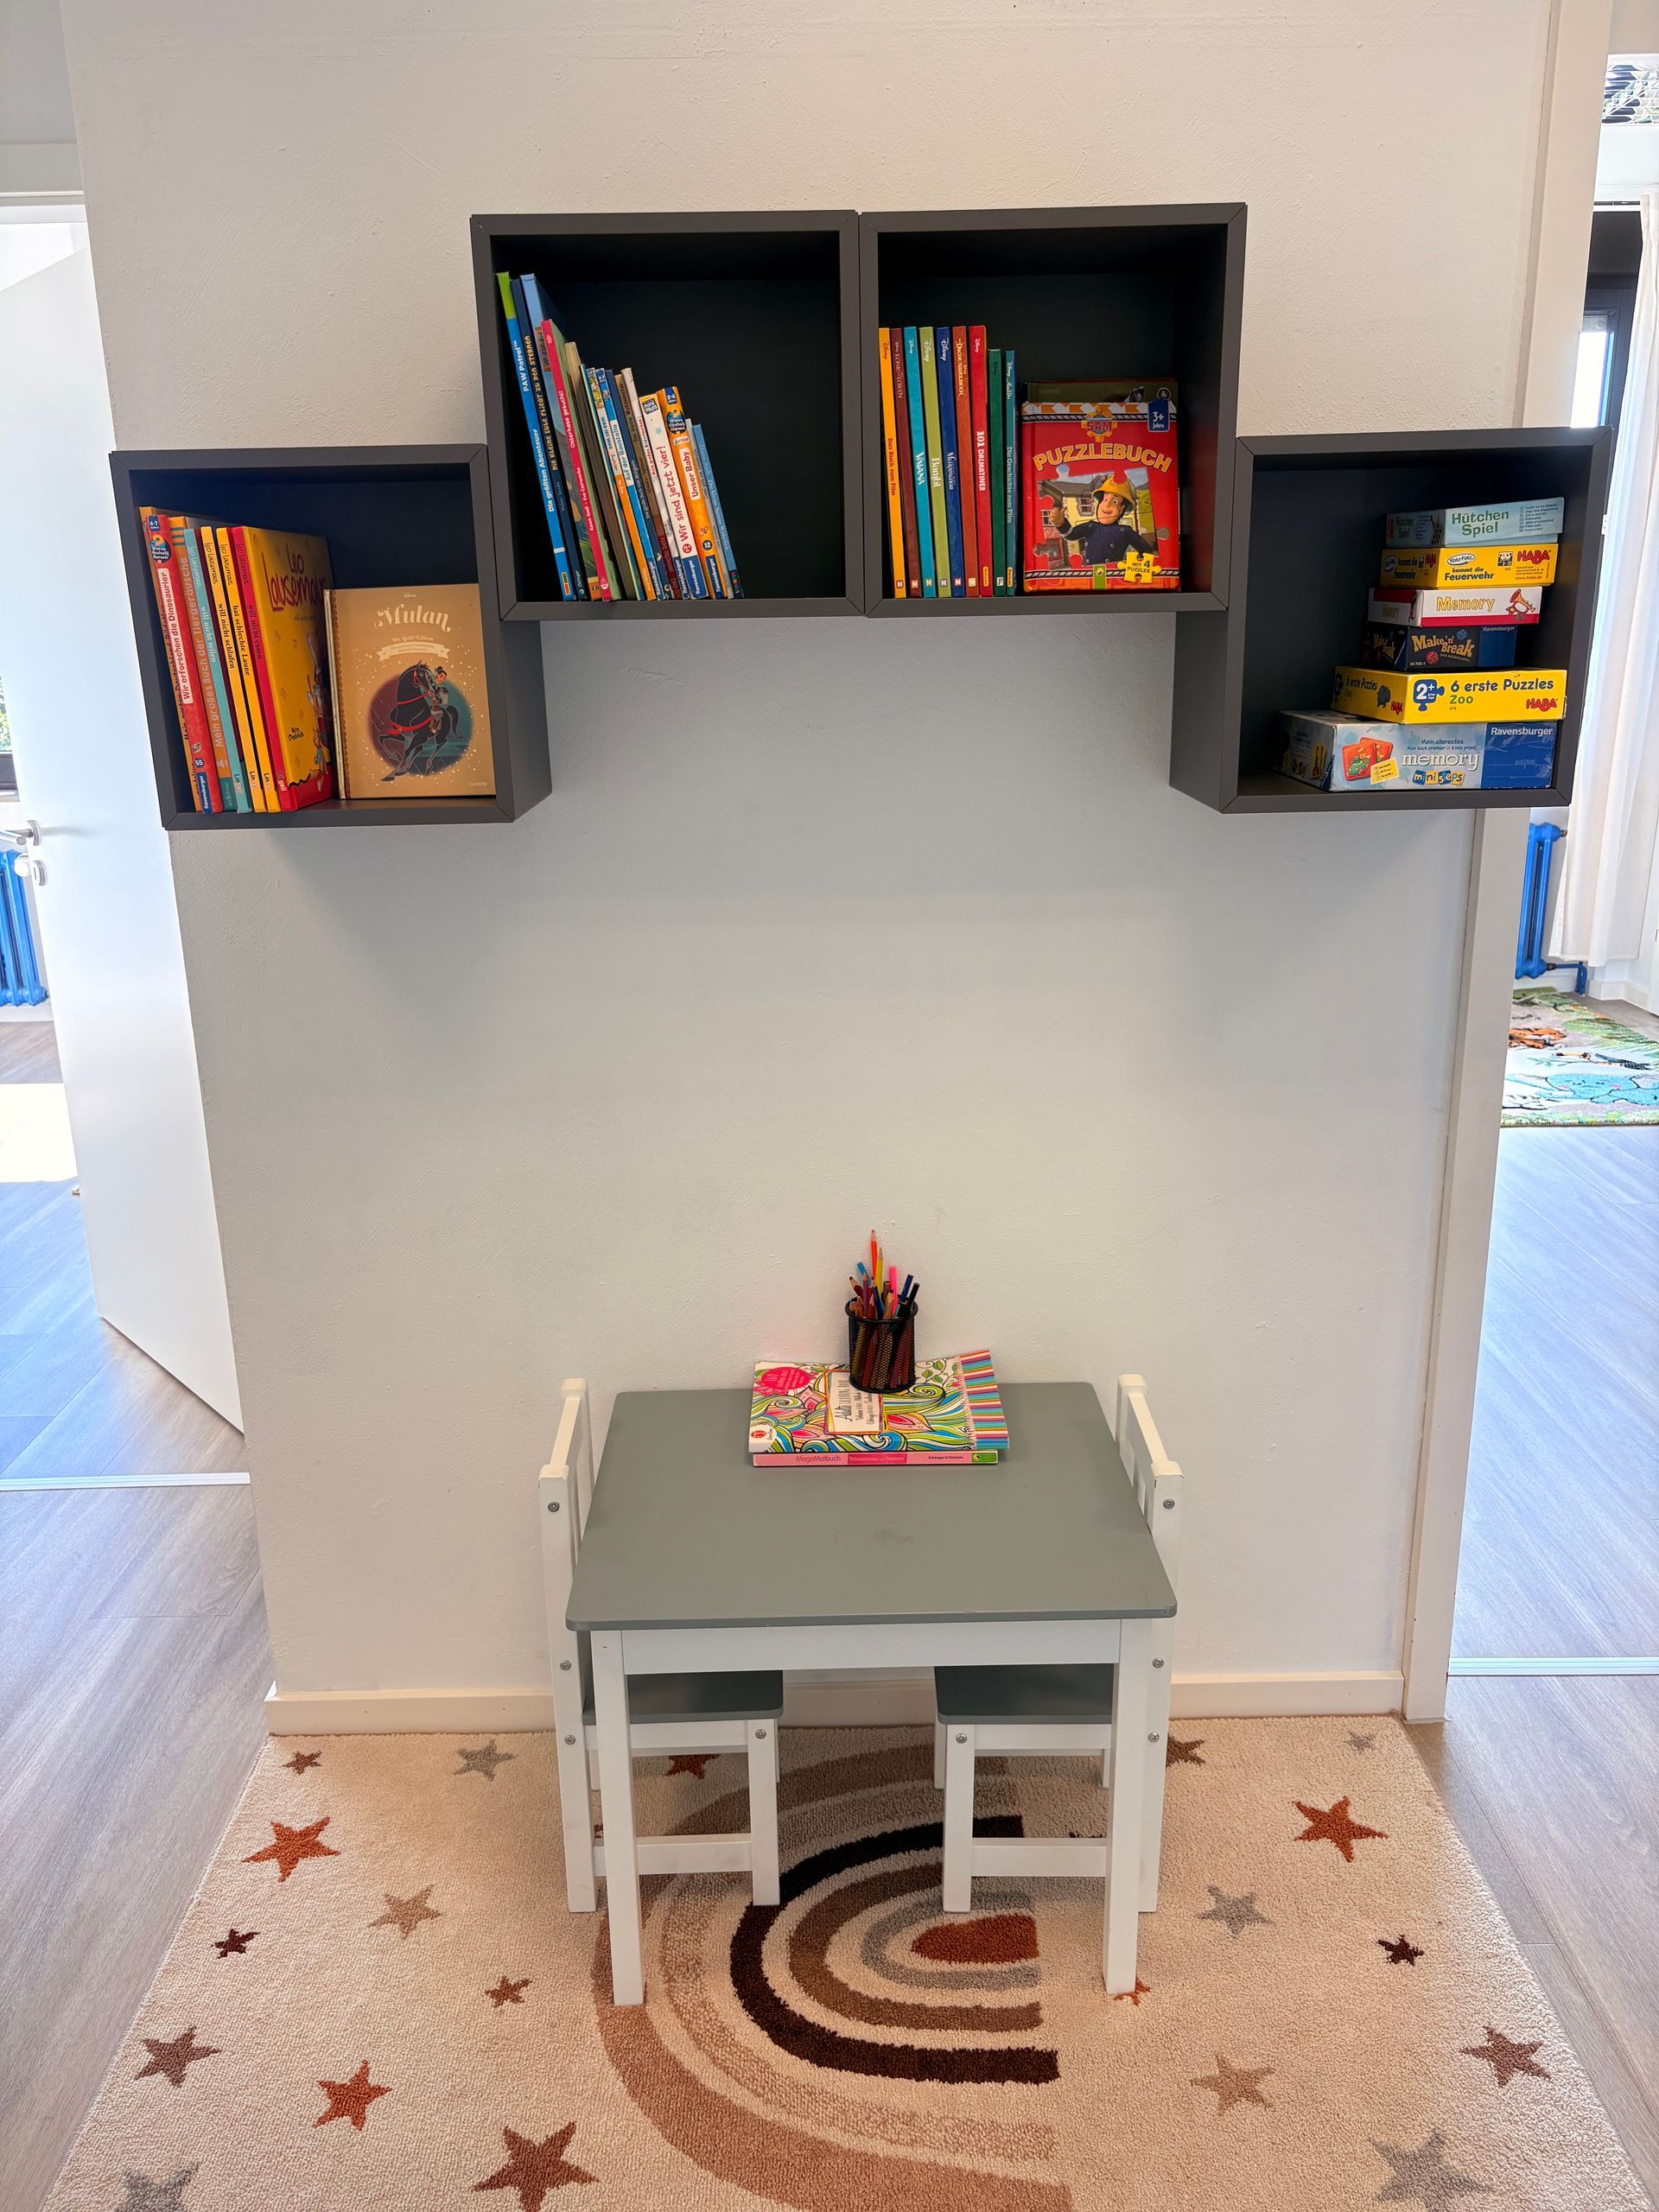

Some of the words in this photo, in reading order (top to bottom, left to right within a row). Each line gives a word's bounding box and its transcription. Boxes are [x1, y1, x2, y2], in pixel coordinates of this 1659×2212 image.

[923, 339, 931, 363] Disney
[940, 337, 949, 361] Disney
[558, 391, 569, 416] gesucht!
[1153, 411, 1164, 422] 3+
[565, 417, 575, 448] Osterhase
[613, 423, 625, 455] Baustelle
[976, 430, 985, 448] 101
[532, 429, 546, 469] Abenteuer
[657, 446, 670, 469] vier!
[1032, 442, 1172, 473] PUZZLEBUCH
[683, 451, 692, 472] Baby
[915, 451, 925, 486] VAIANA
[931, 458, 941, 487] Bambi
[977, 448, 986, 492] DALMATINER
[541, 469, 553, 499] größten
[664, 470, 681, 499] jetzt
[690, 474, 699, 498] Unser
[546, 499, 555, 512] Die
[671, 500, 684, 522] sind
[1452, 510, 1509, 525] Hütchen
[678, 524, 690, 543] Wir
[1462, 521, 1498, 537] Spiel
[286, 543, 304, 574] Leo
[1517, 550, 1549, 564] HABA
[649, 561, 662, 596] Ravensburger
[675, 559, 688, 594] Ravensburger
[689, 560, 700, 594] Ravensburger
[709, 558, 721, 593] Ravensburger
[1445, 571, 1495, 581] Feuerwehr
[161, 572, 176, 626] Dinosaurier
[180, 556, 200, 636] Tiergeräusche
[1436, 596, 1496, 612] Memory
[221, 619, 230, 638] nicht
[374, 603, 451, 632] Mulan
[204, 620, 213, 641] nicht
[235, 619, 246, 652] schlechte
[251, 620, 259, 641] nicht
[197, 638, 206, 657] der
[225, 639, 235, 669] schlafen
[1412, 635, 1444, 653] Make
[1440, 639, 1476, 658] Break
[175, 639, 188, 688] erforschen
[202, 658, 211, 683] Buch
[180, 686, 190, 700] Wir
[1416, 683, 1434, 700] 2+
[1450, 682, 1459, 692] 6
[1464, 683, 1498, 692] erste
[1503, 678, 1554, 690] Puzzles
[206, 683, 219, 721] großes
[1449, 695, 1473, 704] Zoo
[1526, 698, 1557, 712] HABA
[213, 719, 223, 747] Mein
[1491, 727, 1553, 736] Ravensburger
[1401, 753, 1479, 772] memory
[200, 776, 209, 810] Ravensburger
